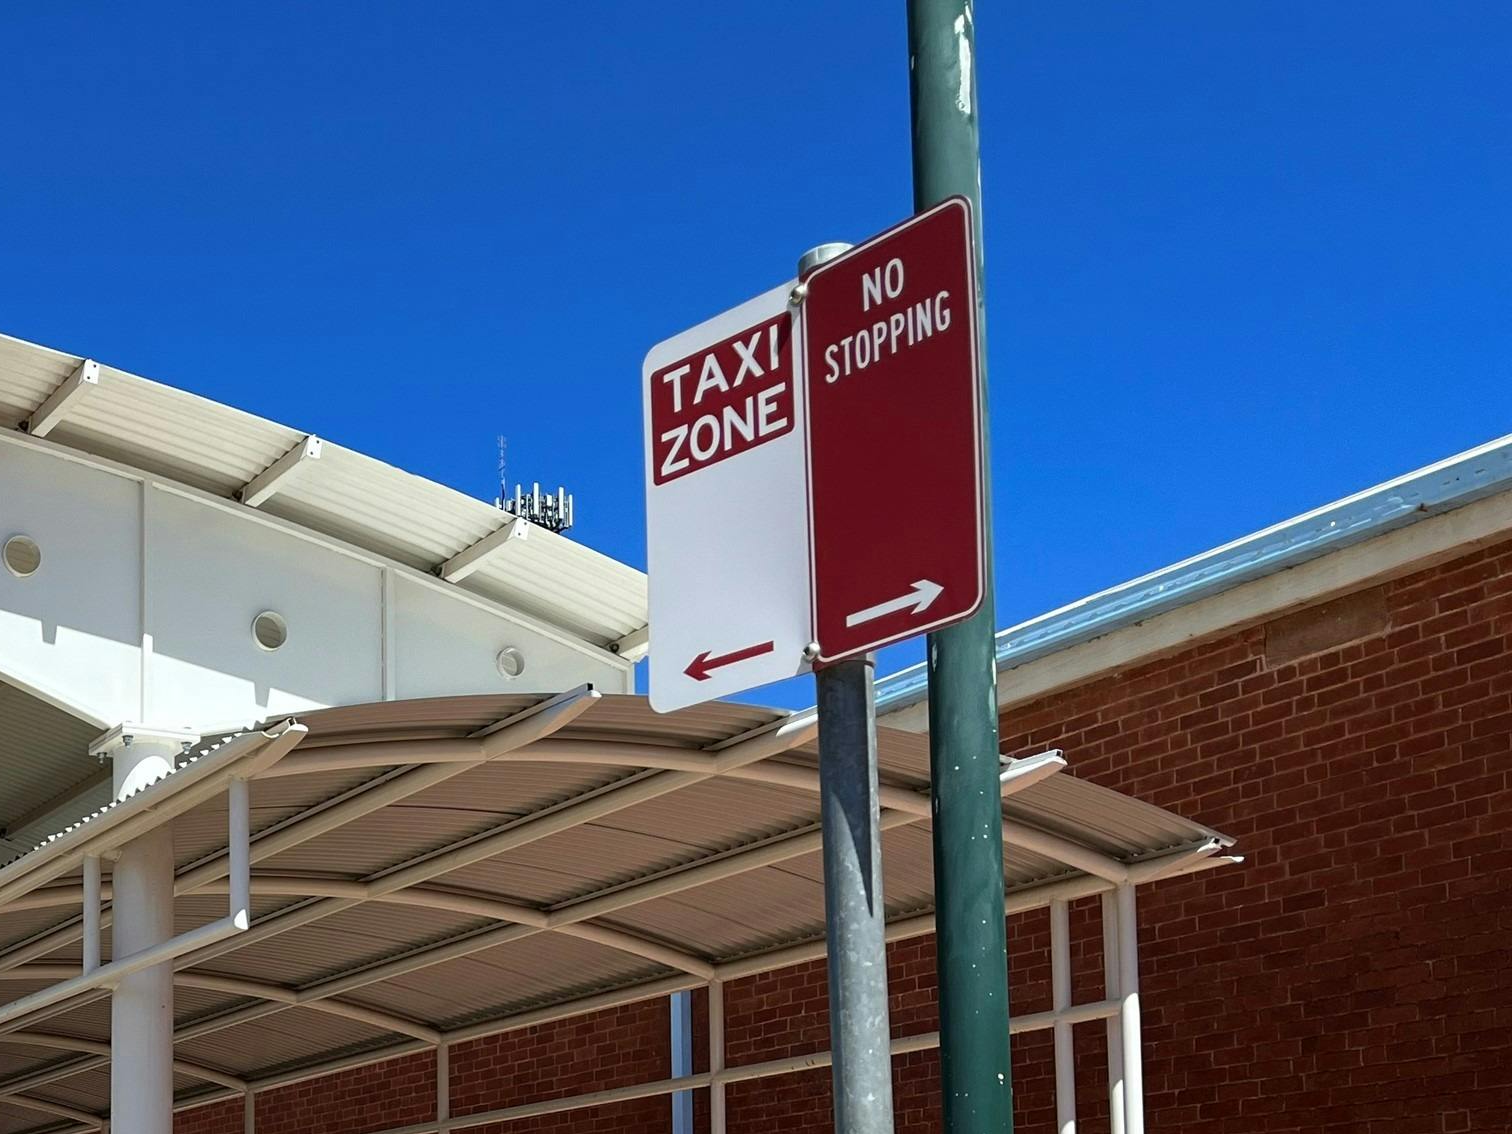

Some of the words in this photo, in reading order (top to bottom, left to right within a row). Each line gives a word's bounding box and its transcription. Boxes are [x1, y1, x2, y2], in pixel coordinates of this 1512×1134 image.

[861, 257, 905, 312] NO
[663, 323, 780, 413] TAXI
[823, 290, 952, 385] STOPPING
[660, 381, 788, 477] ZONE
